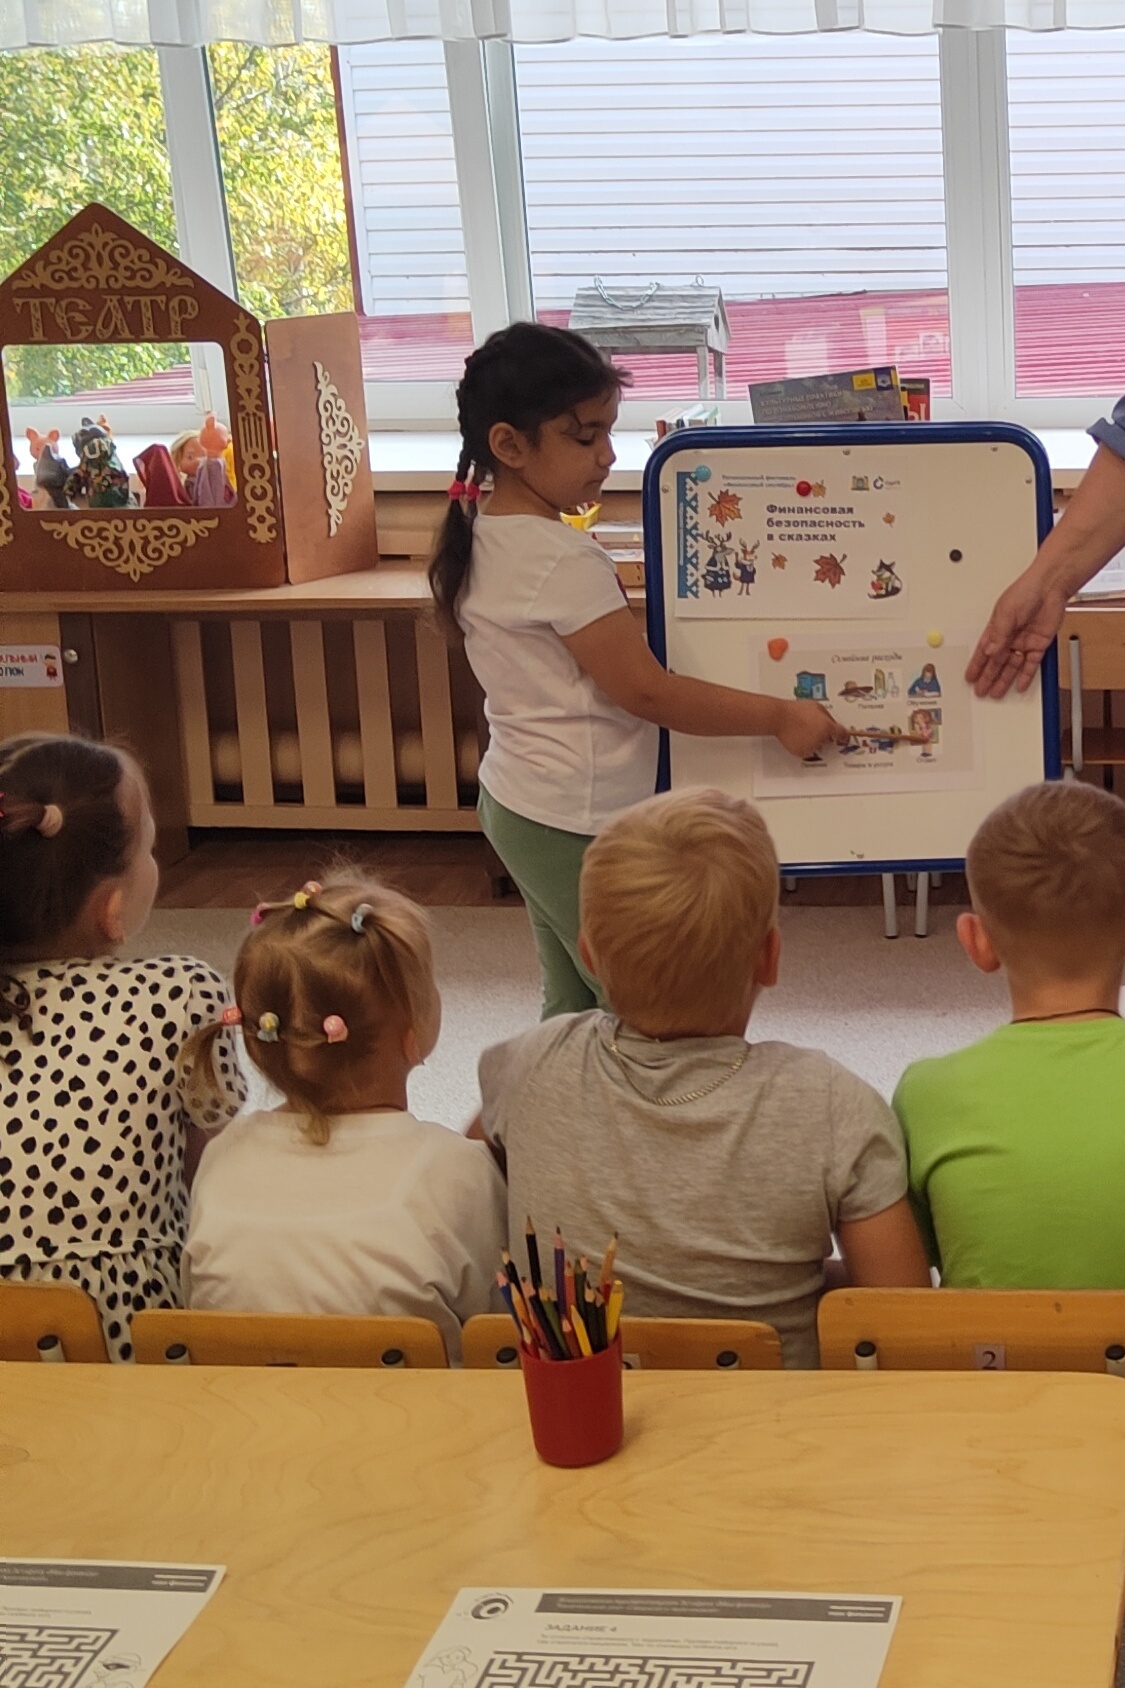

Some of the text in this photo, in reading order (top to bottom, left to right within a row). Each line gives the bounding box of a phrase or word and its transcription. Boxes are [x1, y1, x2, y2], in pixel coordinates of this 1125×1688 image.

[13, 295, 198, 341] ТЕАТР
[766, 504, 854, 514] Финансовая
[766, 518, 865, 528] безопасность
[778, 533, 837, 541] сказках
[982, 1350, 997, 1370] 2
[544, 1624, 608, 1632] ЗАДАНИЕ
